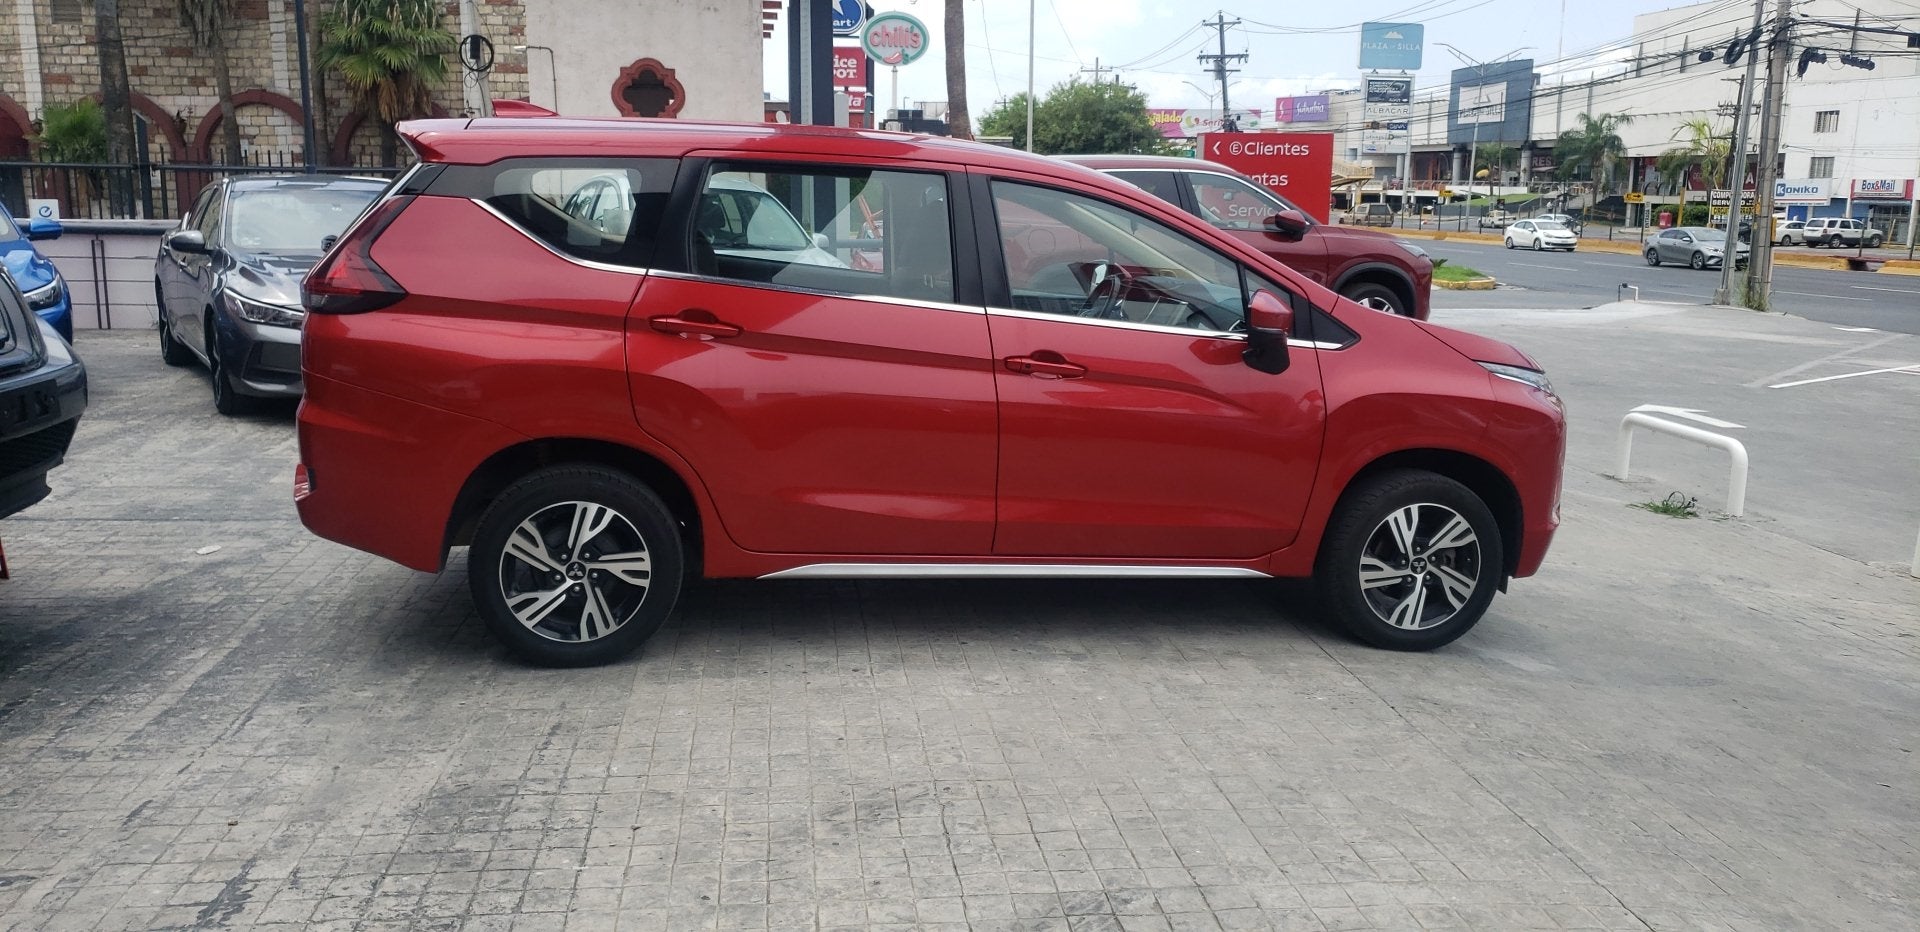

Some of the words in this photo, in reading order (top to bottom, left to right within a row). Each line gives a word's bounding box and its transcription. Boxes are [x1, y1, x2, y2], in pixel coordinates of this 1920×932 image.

[834, 55, 857, 68] ice
[1148, 110, 1182, 126] galado
[1244, 141, 1310, 156] Clientes
[1246, 172, 1289, 186] ntas
[1861, 180, 1896, 191] Box&Mail
[1228, 204, 1276, 217] Servic
